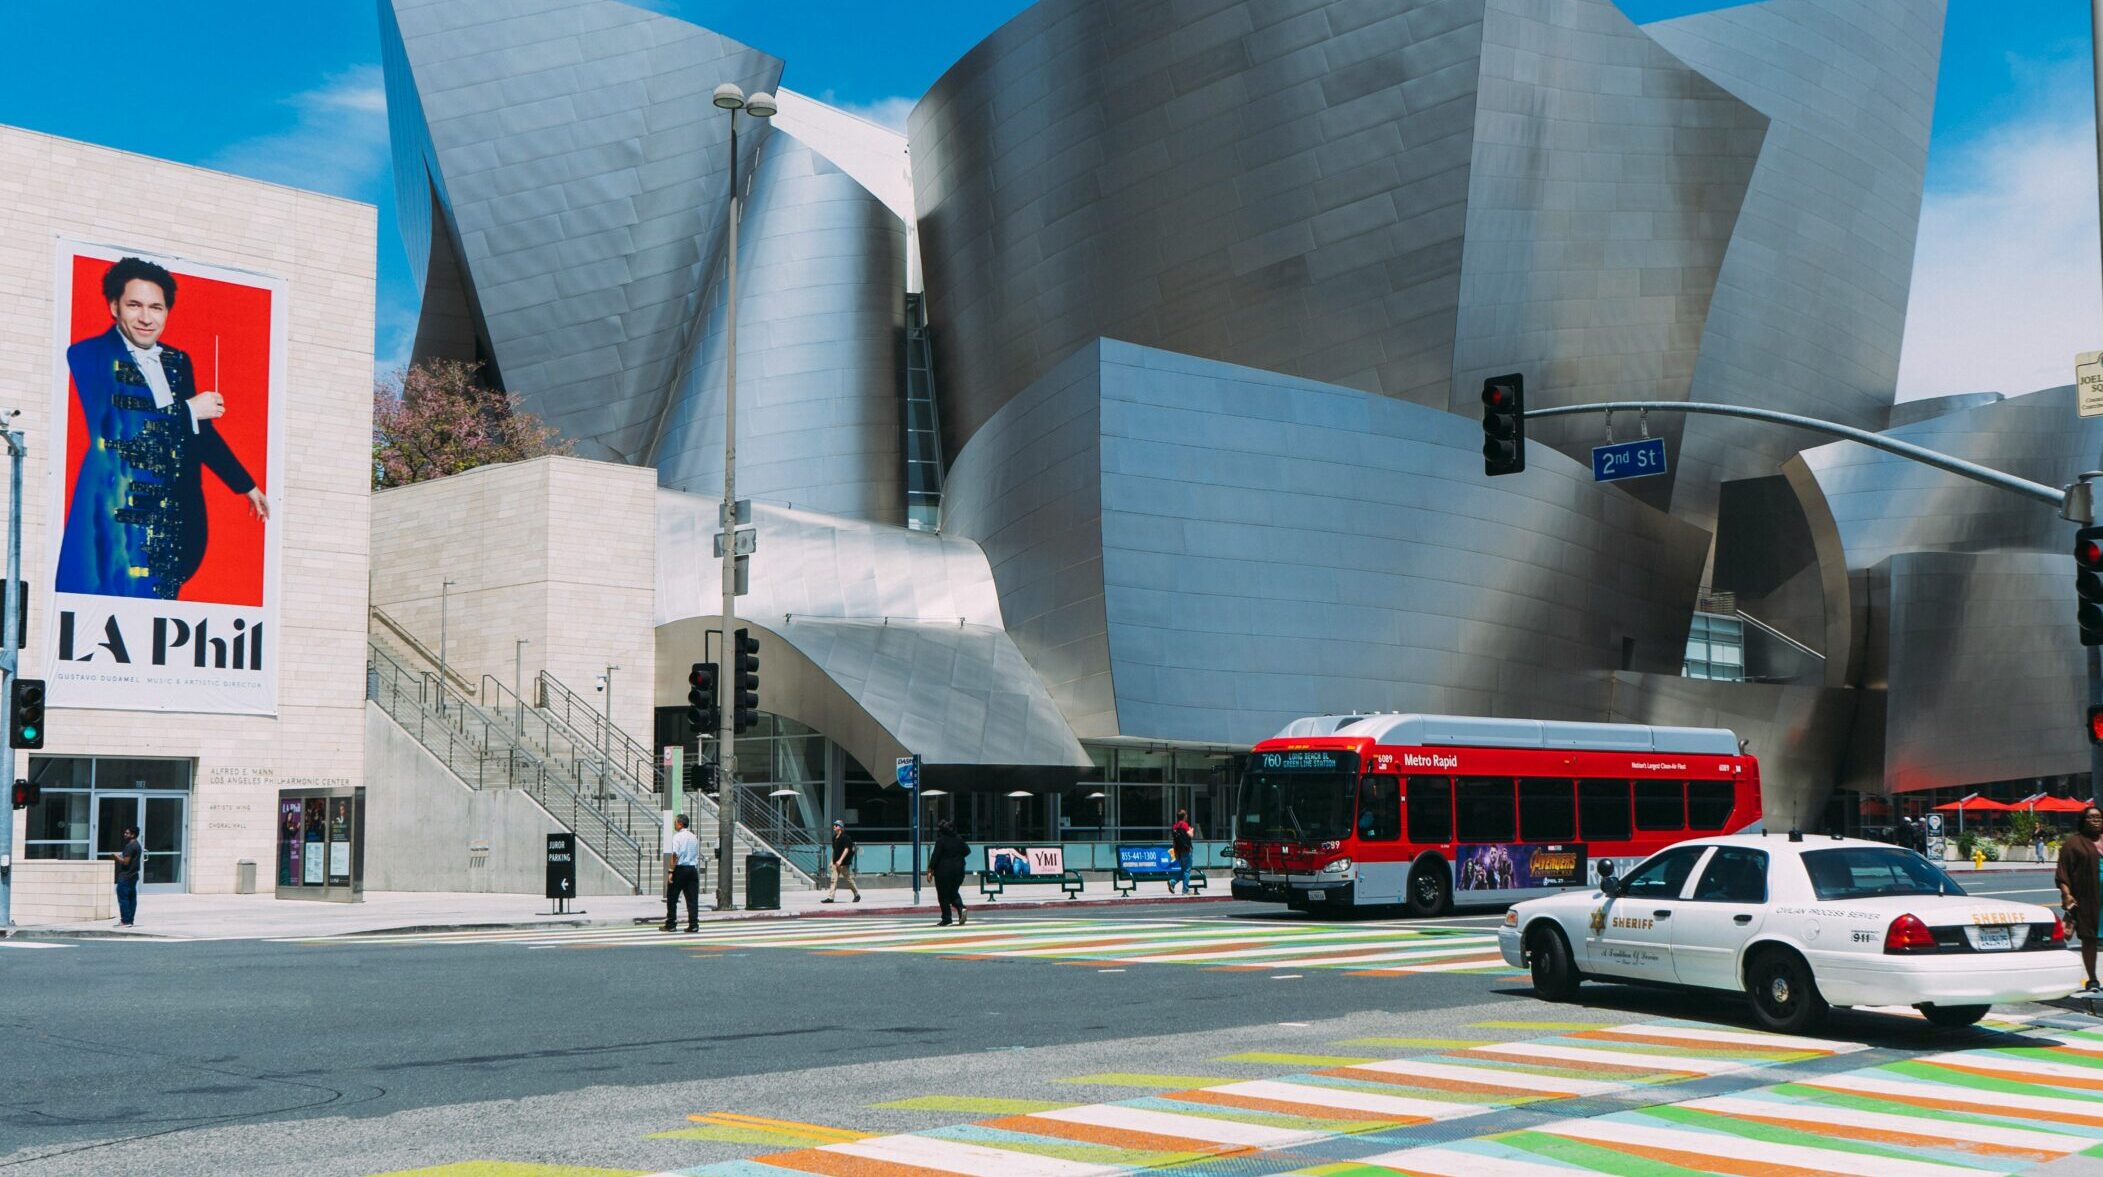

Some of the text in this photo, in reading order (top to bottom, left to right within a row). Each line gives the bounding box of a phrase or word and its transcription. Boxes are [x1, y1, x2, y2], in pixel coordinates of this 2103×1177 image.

[2080, 375, 2103, 385] JOEL
[1602, 449, 1656, 474] 2nd St
[59, 611, 263, 670] LA Phil
[58, 673, 97, 681] GUSTAVO
[100, 675, 140, 683] DUDAMEL
[1262, 753, 1282, 767] 760
[1378, 754, 1393, 763] 6089
[1404, 753, 1457, 770] Metro Rapid
[1283, 760, 1299, 768] GREEN
[1300, 760, 1312, 768] LINE
[211, 768, 239, 776] ALFRED
[227, 777, 261, 785] ANGELES
[549, 841, 565, 849] JUROR
[549, 853, 570, 861] PARKING
[1035, 851, 1057, 866] YMI
[1121, 851, 1157, 861] 855-441-1300
[1530, 849, 1576, 872] AVENGERS
[1809, 908, 1845, 917] PROCESS
[1847, 911, 1881, 919] SERVER
[1972, 912, 2025, 925] SHERIFF
[1612, 917, 1654, 930] SHERIFF
